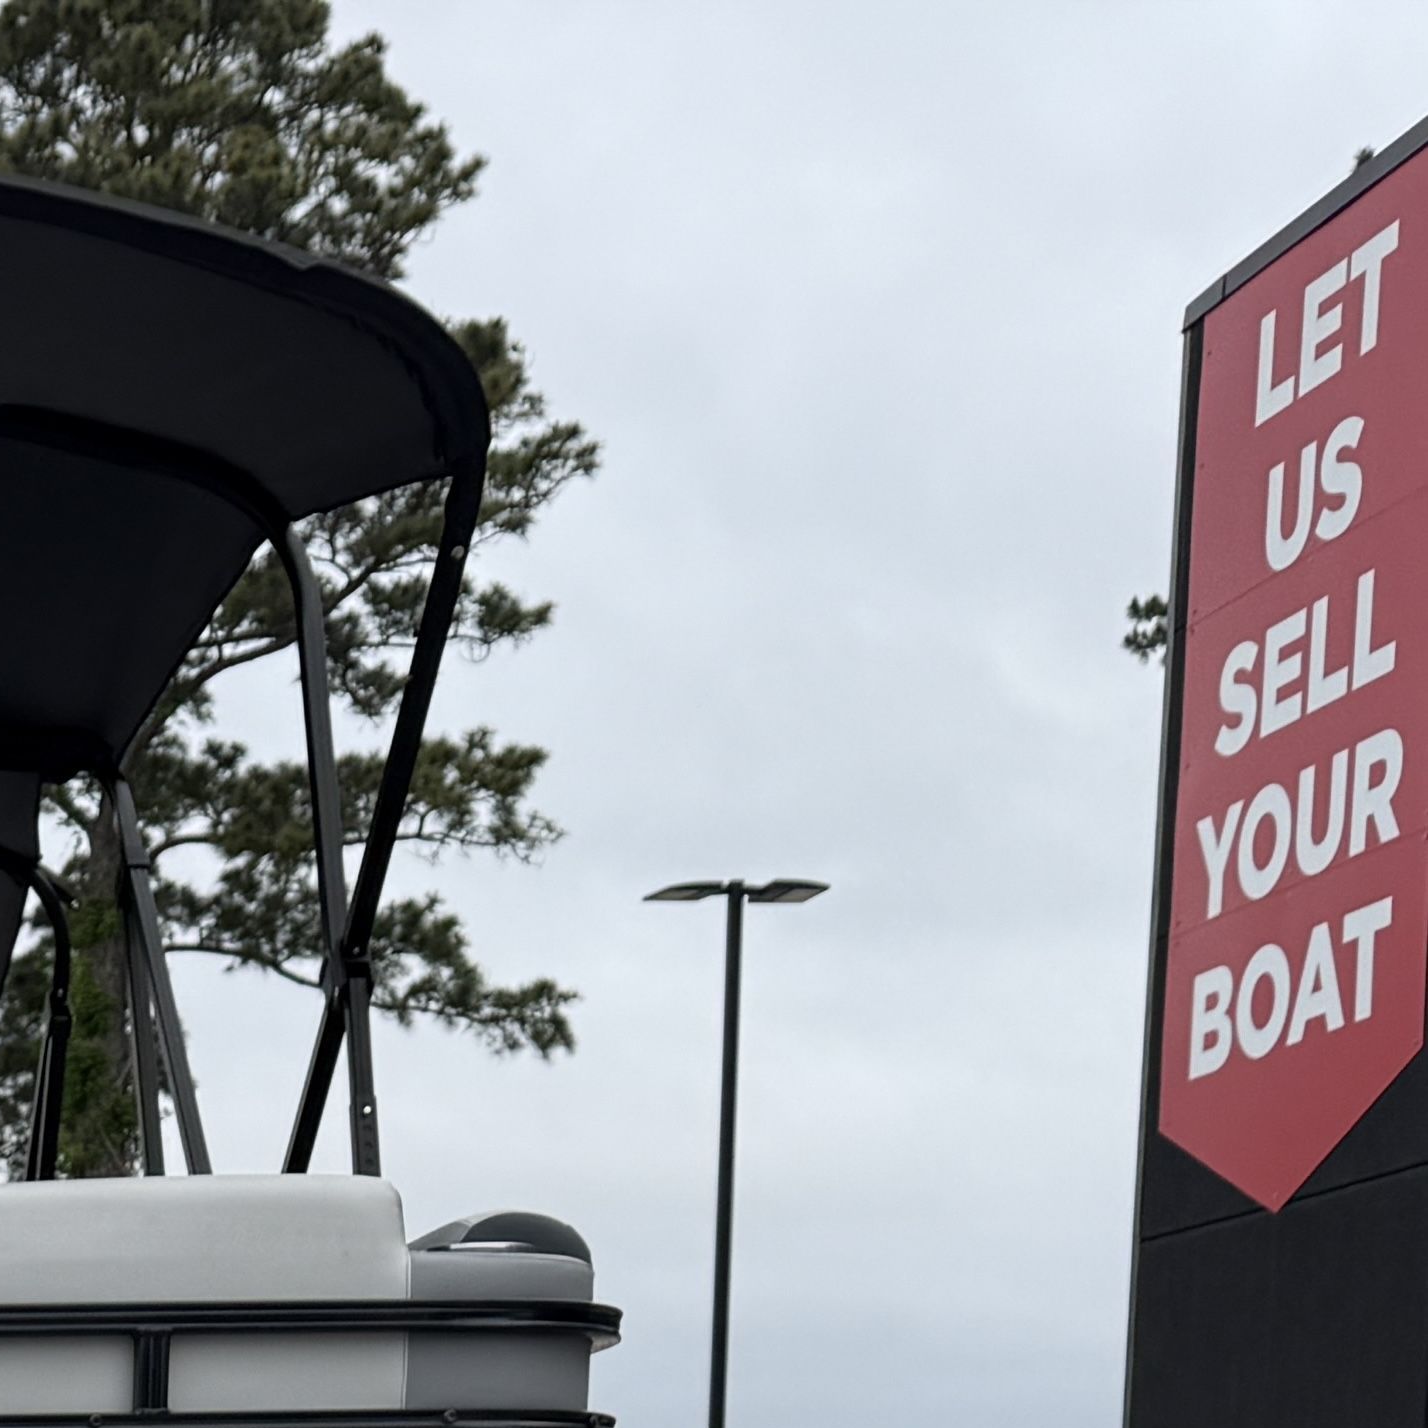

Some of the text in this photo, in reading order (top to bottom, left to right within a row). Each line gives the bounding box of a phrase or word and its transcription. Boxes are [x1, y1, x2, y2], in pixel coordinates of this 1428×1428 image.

[1255, 218, 1400, 428] LET
[1265, 415, 1365, 572] US
[1214, 568, 1396, 757] SELL
[1196, 728, 1404, 920] YOUR
[1187, 895, 1394, 1081] BOAT
